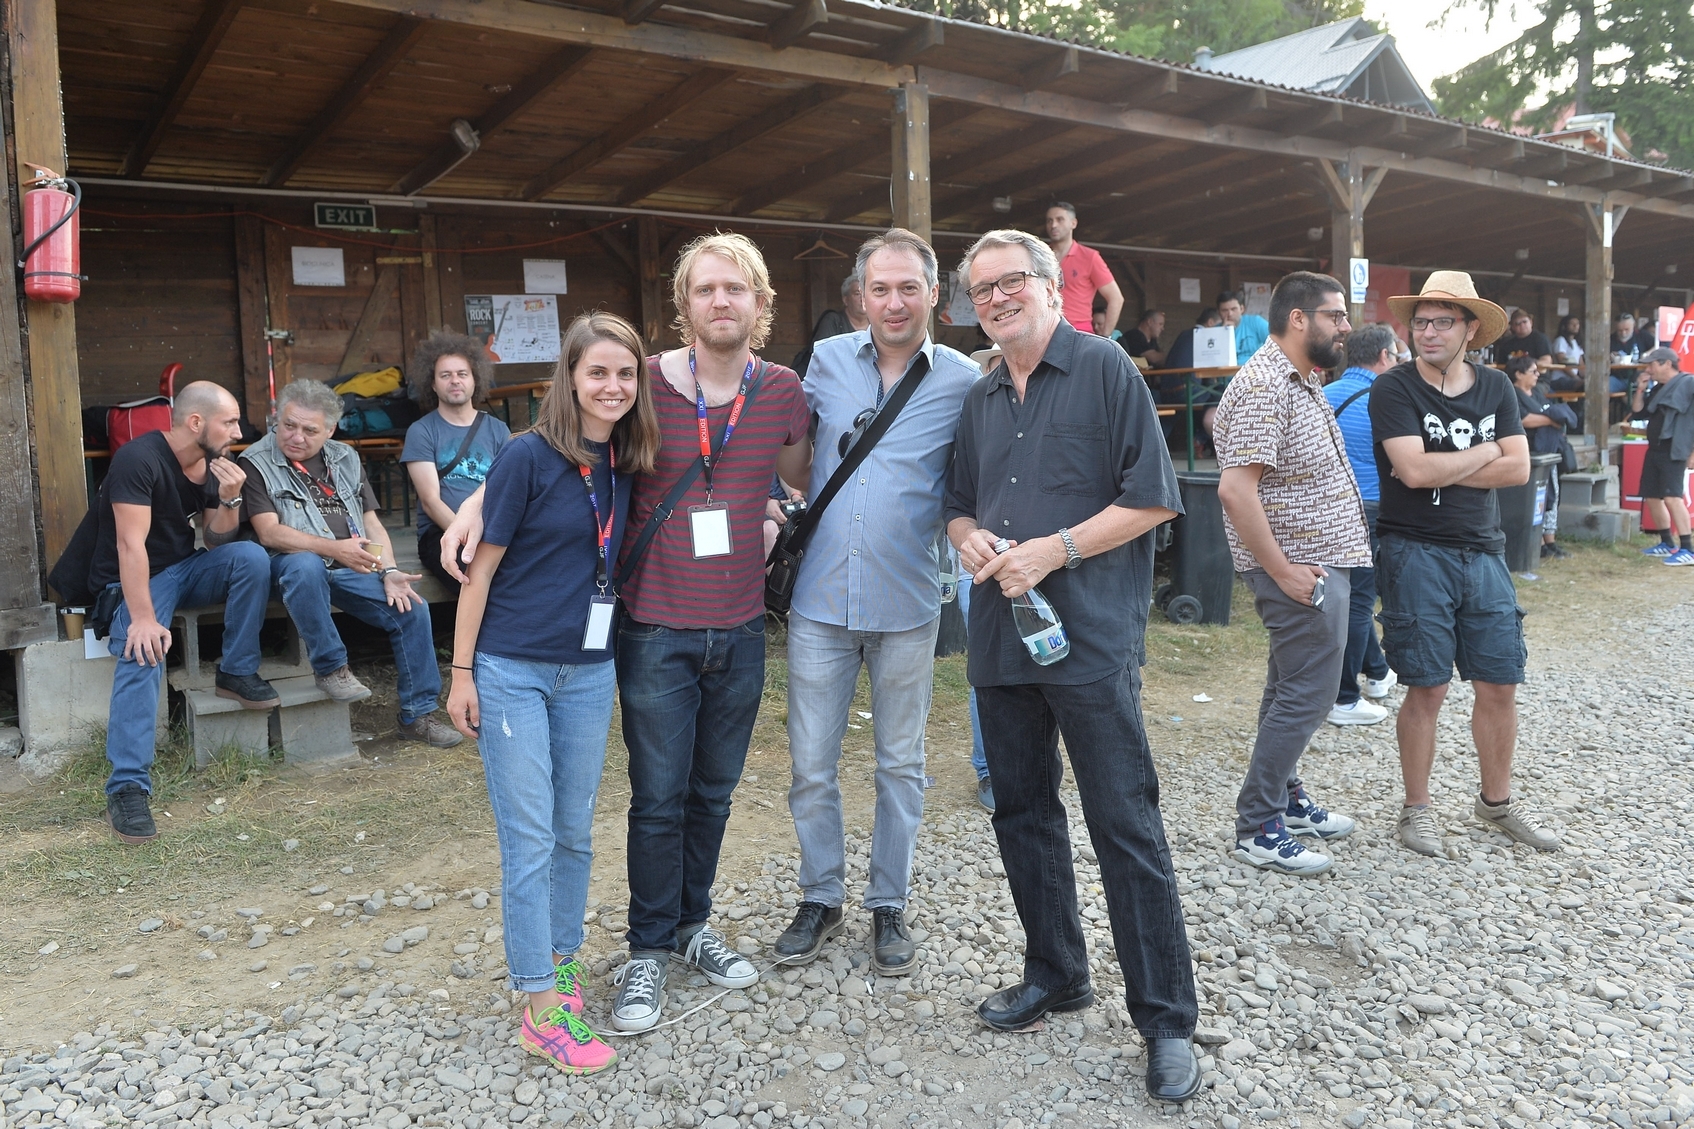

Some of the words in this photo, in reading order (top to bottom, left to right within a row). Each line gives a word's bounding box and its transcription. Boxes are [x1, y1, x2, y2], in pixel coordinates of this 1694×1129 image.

[325, 208, 366, 224] EXIT
[470, 308, 492, 321] ROCK
[730, 403, 742, 426] EDITION
[699, 418, 708, 443] EDITION
[584, 475, 592, 488] GJF
[589, 493, 597, 508] 2017
[1289, 499, 1313, 508] hexapod
[1264, 502, 1285, 511] exapod
[1286, 518, 1311, 527] hexapod
[1275, 526, 1301, 534] hexapod
[1293, 528, 1319, 538] hexapod
[1283, 536, 1308, 545] hexapod
